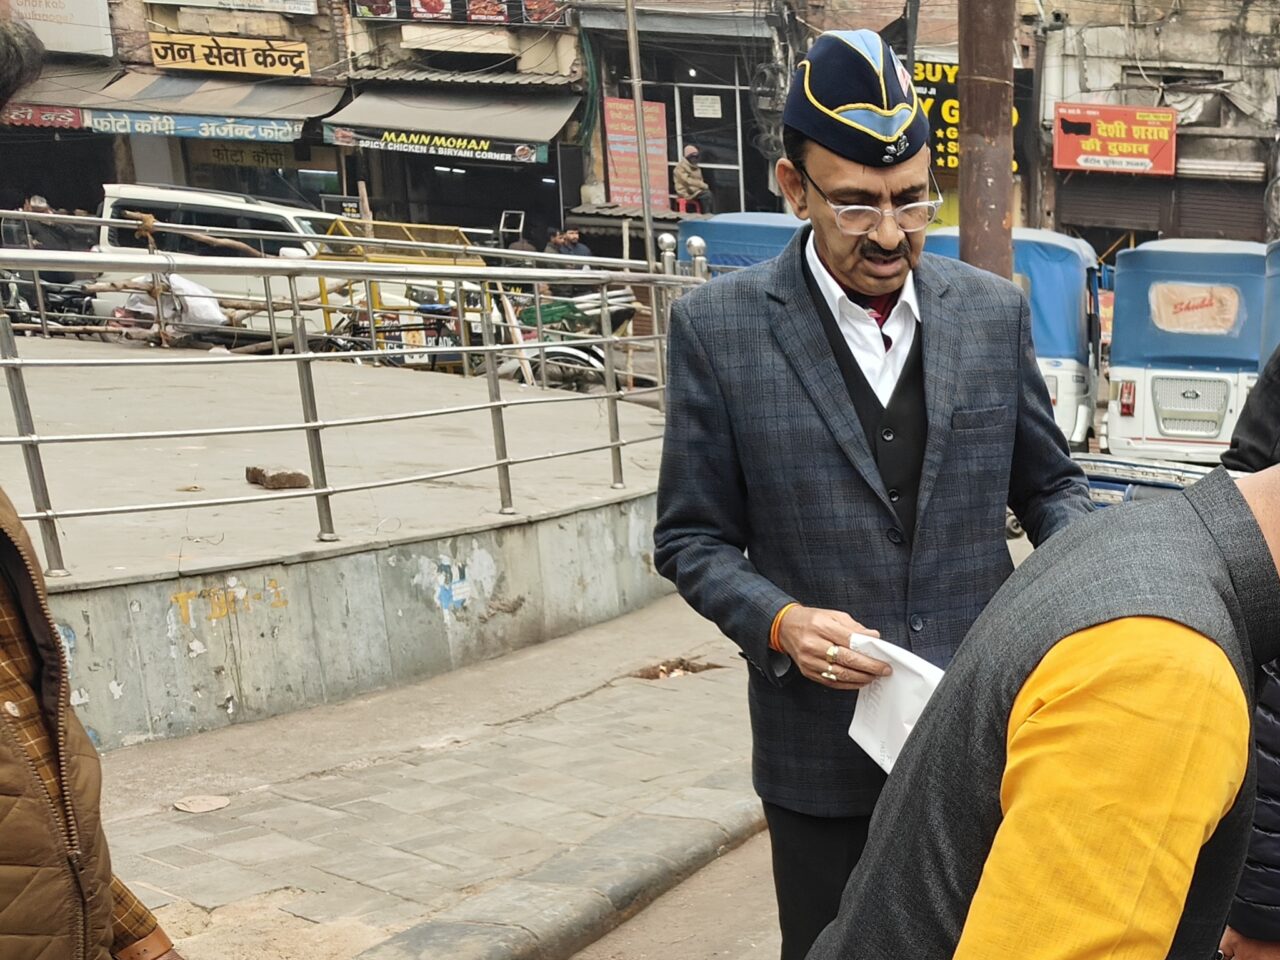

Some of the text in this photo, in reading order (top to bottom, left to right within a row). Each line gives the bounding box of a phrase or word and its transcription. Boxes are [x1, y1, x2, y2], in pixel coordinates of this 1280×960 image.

[151, 37, 305, 74] जन सेवा केन्द्र
[1096, 119, 1127, 138] देशी
[359, 140, 386, 150] SPICY
[387, 142, 427, 154] CHICKEN
[438, 146, 474, 158] BIRYANI
[475, 151, 512, 161] CORNER
[381, 131, 490, 150] MANN MOHAN
